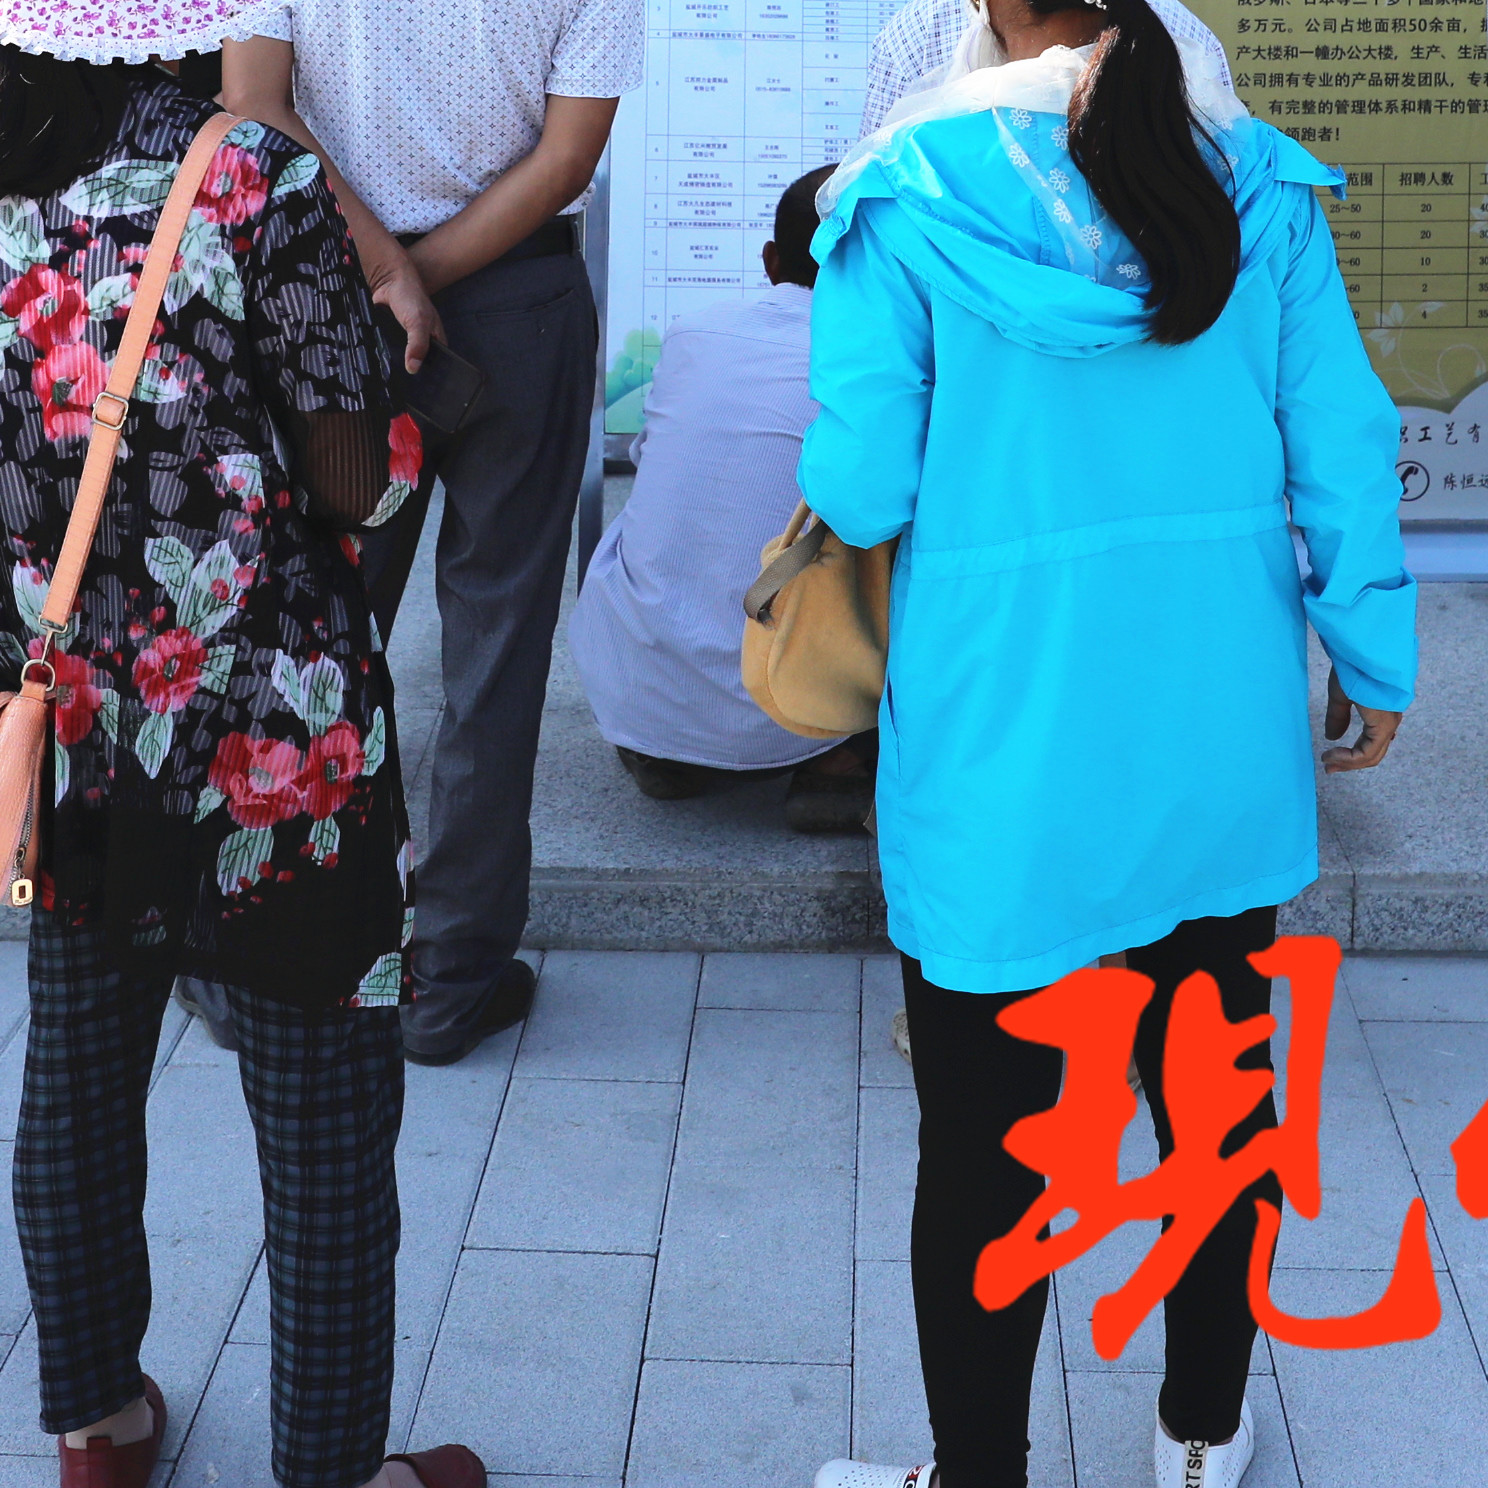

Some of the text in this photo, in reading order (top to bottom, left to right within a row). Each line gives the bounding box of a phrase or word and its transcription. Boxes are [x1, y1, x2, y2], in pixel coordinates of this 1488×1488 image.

[1399, 171, 1454, 187] 招聘人数
[1420, 204, 1432, 213] 20
[1420, 231, 1432, 240] 20
[1420, 257, 1431, 266] 10
[1421, 283, 1428, 293] 2
[1421, 310, 1428, 320] 4
